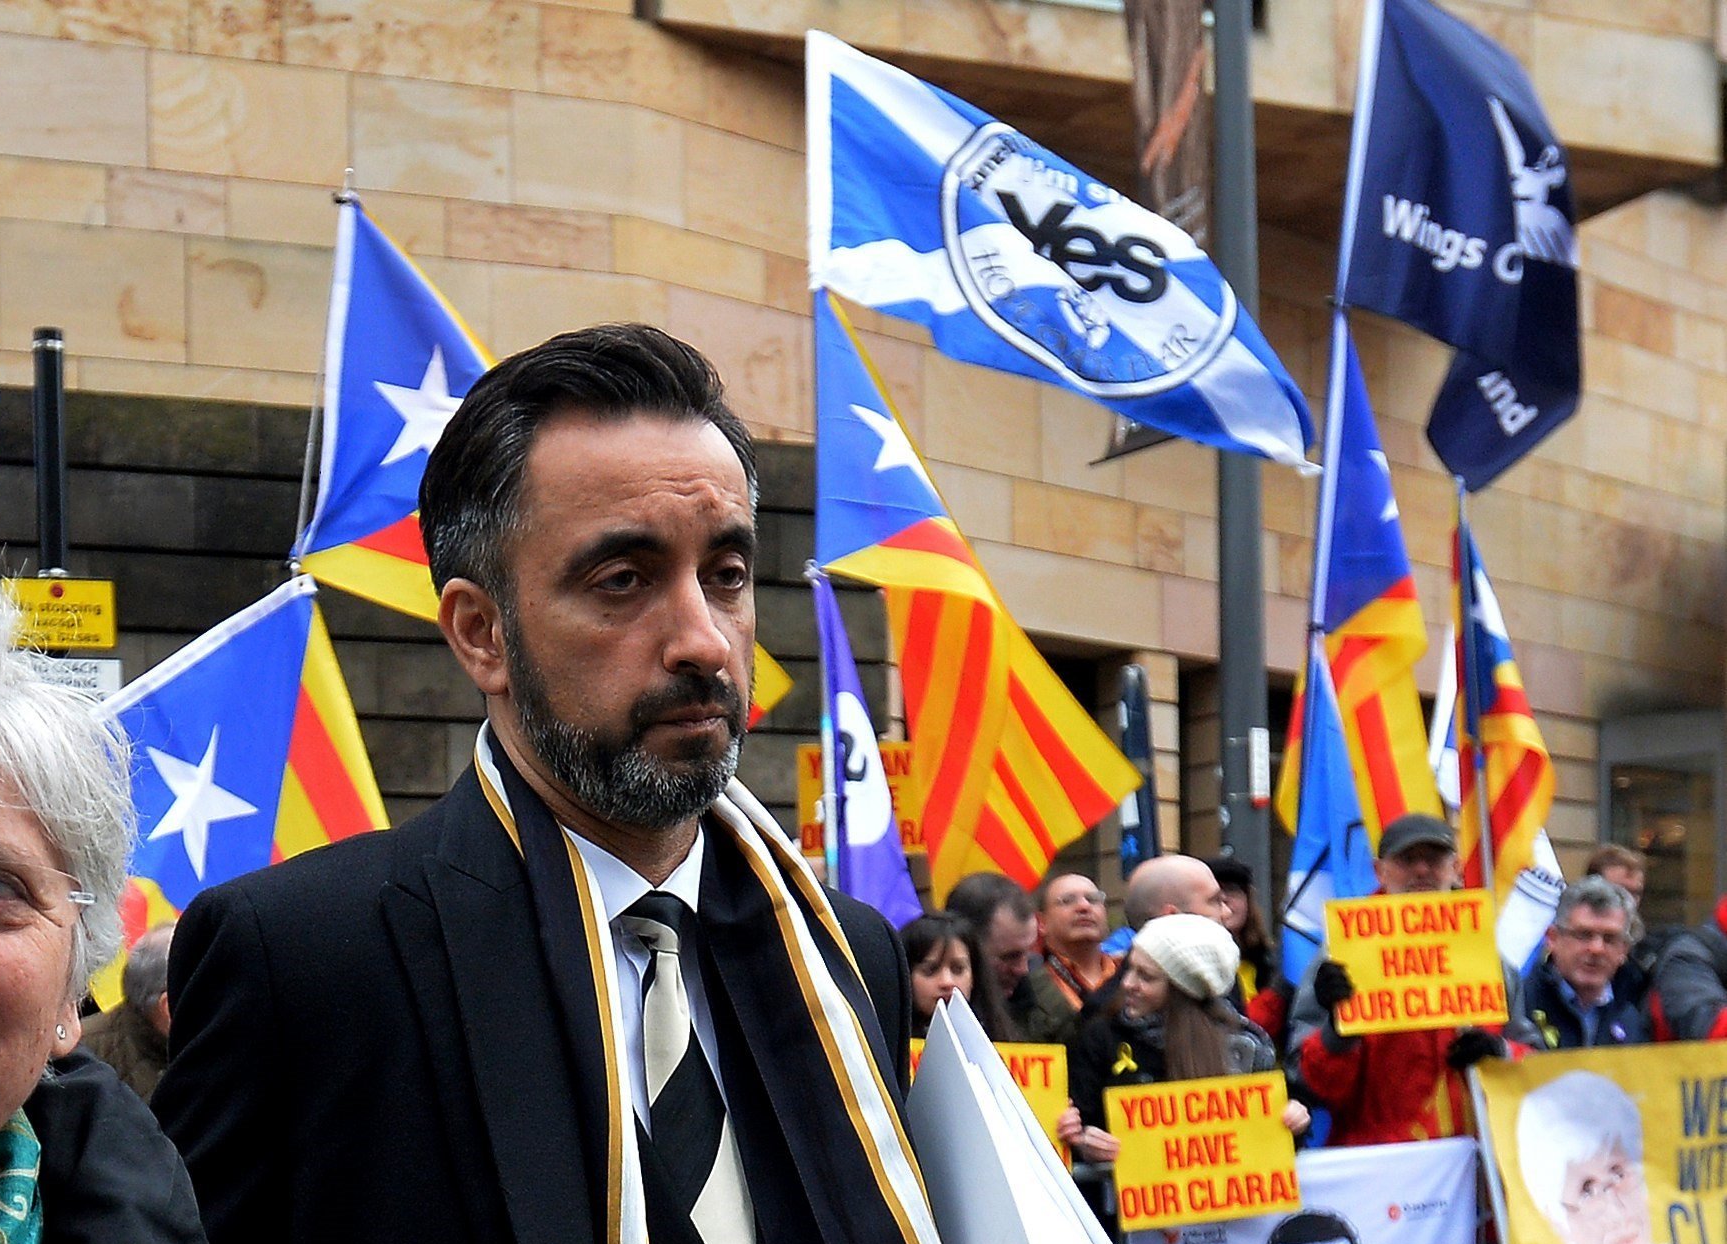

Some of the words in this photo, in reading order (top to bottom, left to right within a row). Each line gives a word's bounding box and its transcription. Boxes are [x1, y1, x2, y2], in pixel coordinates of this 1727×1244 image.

[1382, 194, 1488, 273] Wings
[1337, 905, 1395, 940] YOU
[1400, 900, 1483, 935] CAN'T
[1381, 944, 1452, 978] HAVE
[1339, 988, 1398, 1023] OUR
[1403, 982, 1504, 1019] CLARA!
[1008, 1055, 1055, 1088] N'T
[1120, 1094, 1178, 1131] YOU
[1184, 1082, 1273, 1124] CAN'T
[1164, 1131, 1240, 1171] HAVE
[1121, 1182, 1182, 1220] OUR
[1187, 1167, 1300, 1212] CLARA!
